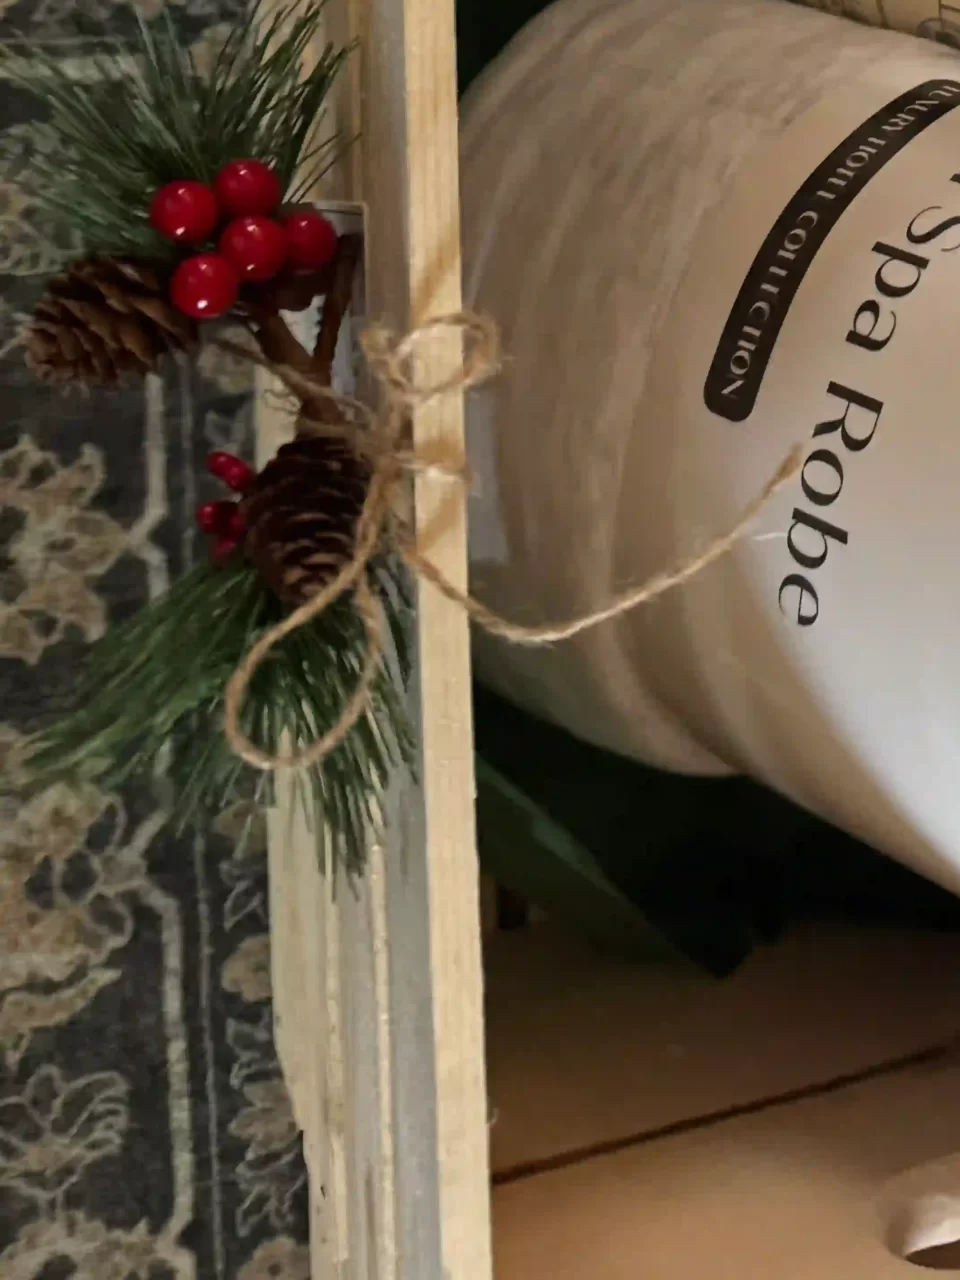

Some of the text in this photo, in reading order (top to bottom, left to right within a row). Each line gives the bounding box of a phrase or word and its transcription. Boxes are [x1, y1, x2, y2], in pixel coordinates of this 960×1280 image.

[816, 137, 886, 201] HOTEL
[720, 210, 819, 400] COLLECTION
[778, 380, 885, 627] Robe
